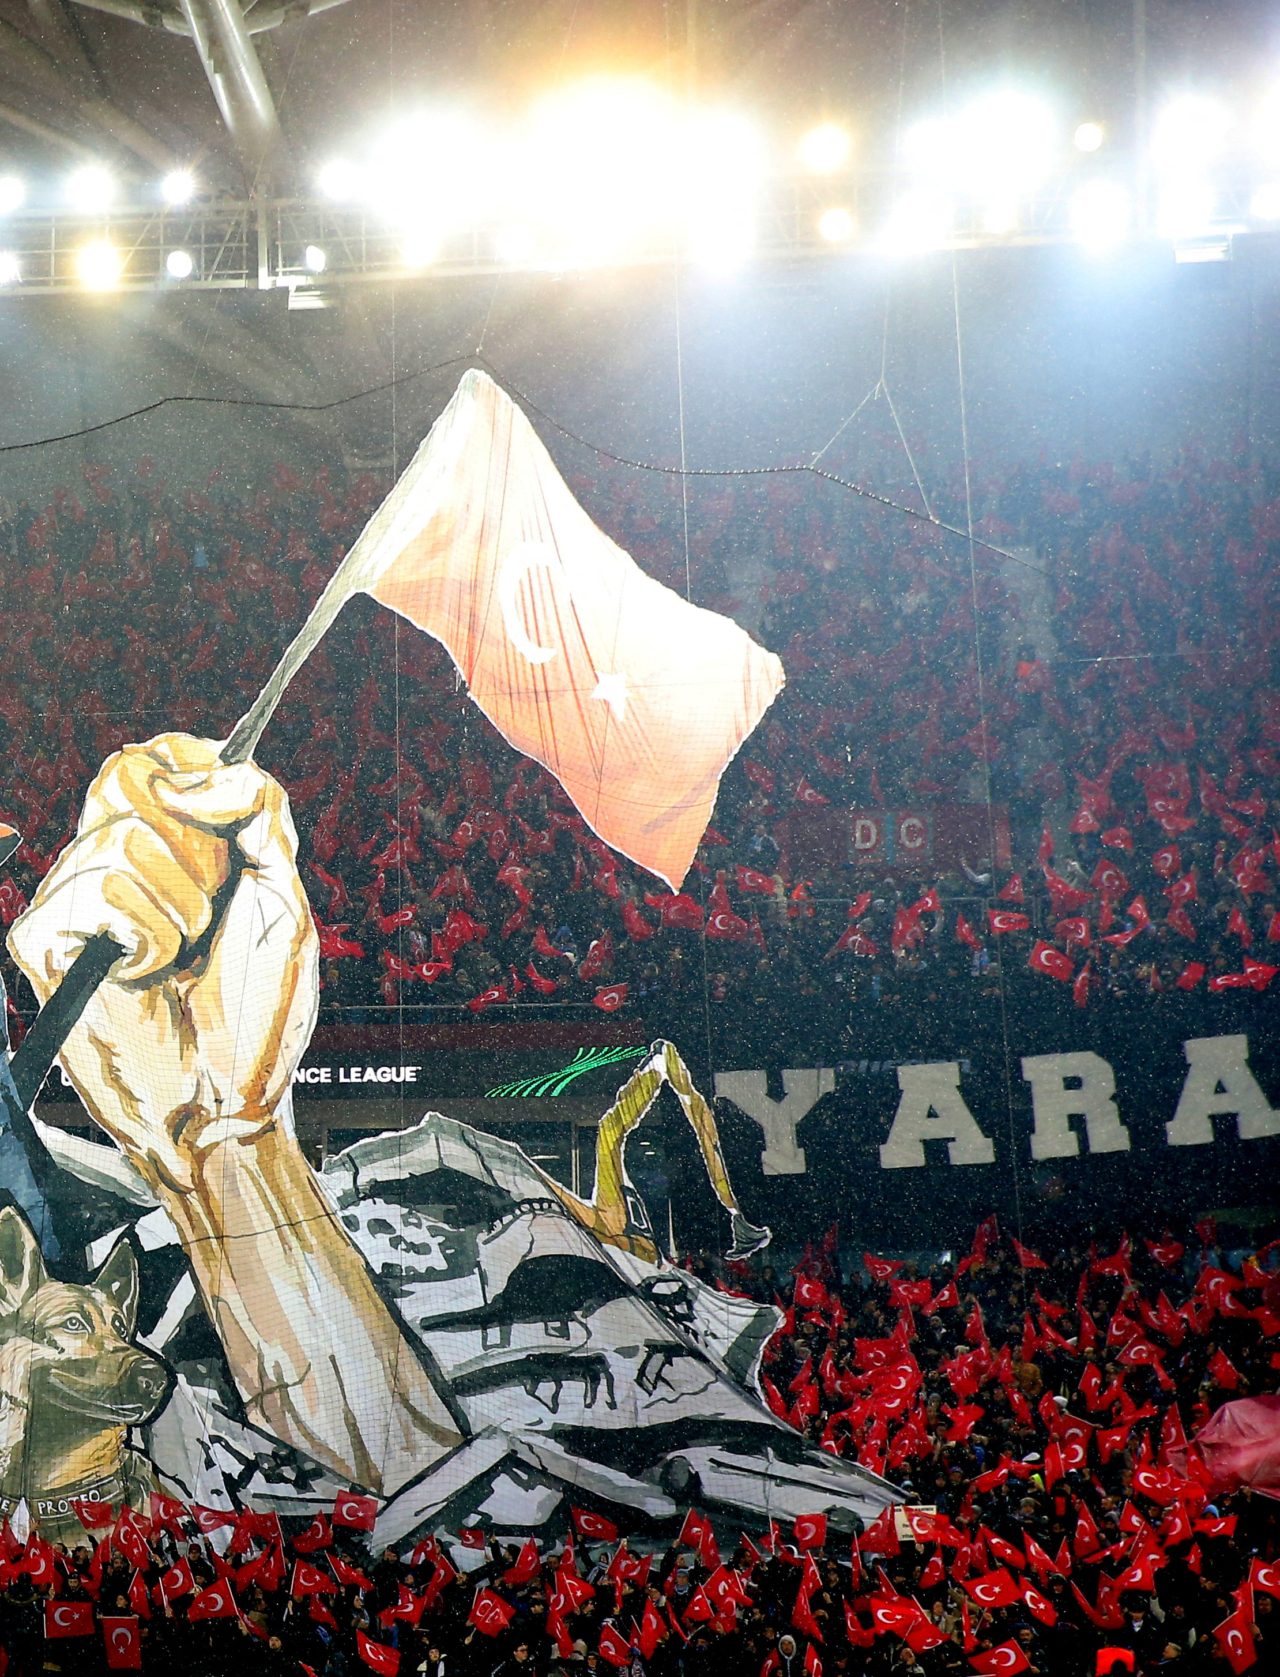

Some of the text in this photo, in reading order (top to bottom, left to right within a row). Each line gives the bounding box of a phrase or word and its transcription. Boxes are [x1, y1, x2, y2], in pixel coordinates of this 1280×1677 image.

[855, 817, 922, 850] D C
[292, 1066, 417, 1083] NCE LEAGUE
[715, 1033, 1280, 1175] YARA
